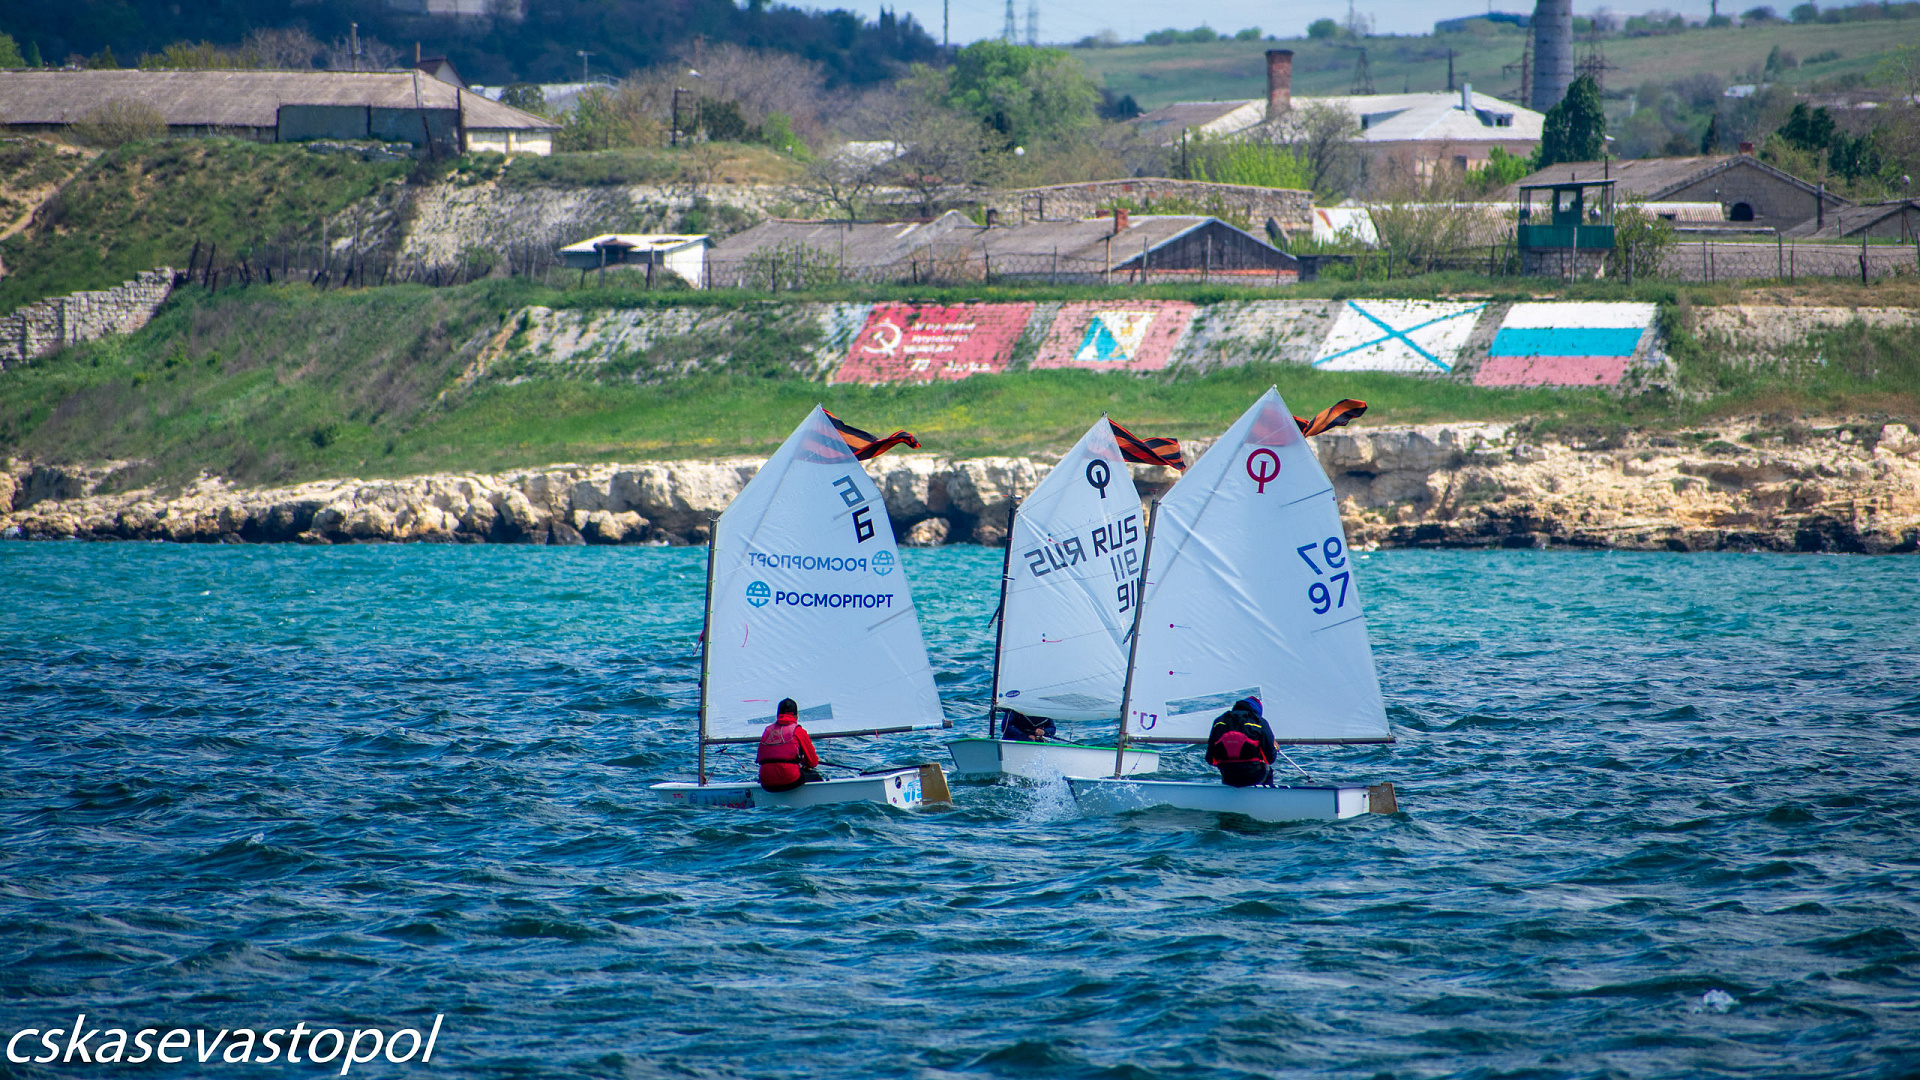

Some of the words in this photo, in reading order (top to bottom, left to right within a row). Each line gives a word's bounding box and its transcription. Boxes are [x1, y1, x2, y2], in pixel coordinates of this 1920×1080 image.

[852, 506, 875, 543] 6
[1092, 514, 1138, 557] RUS
[775, 591, 894, 608] РОСМОРПОРТ
[1308, 571, 1350, 615] 97
